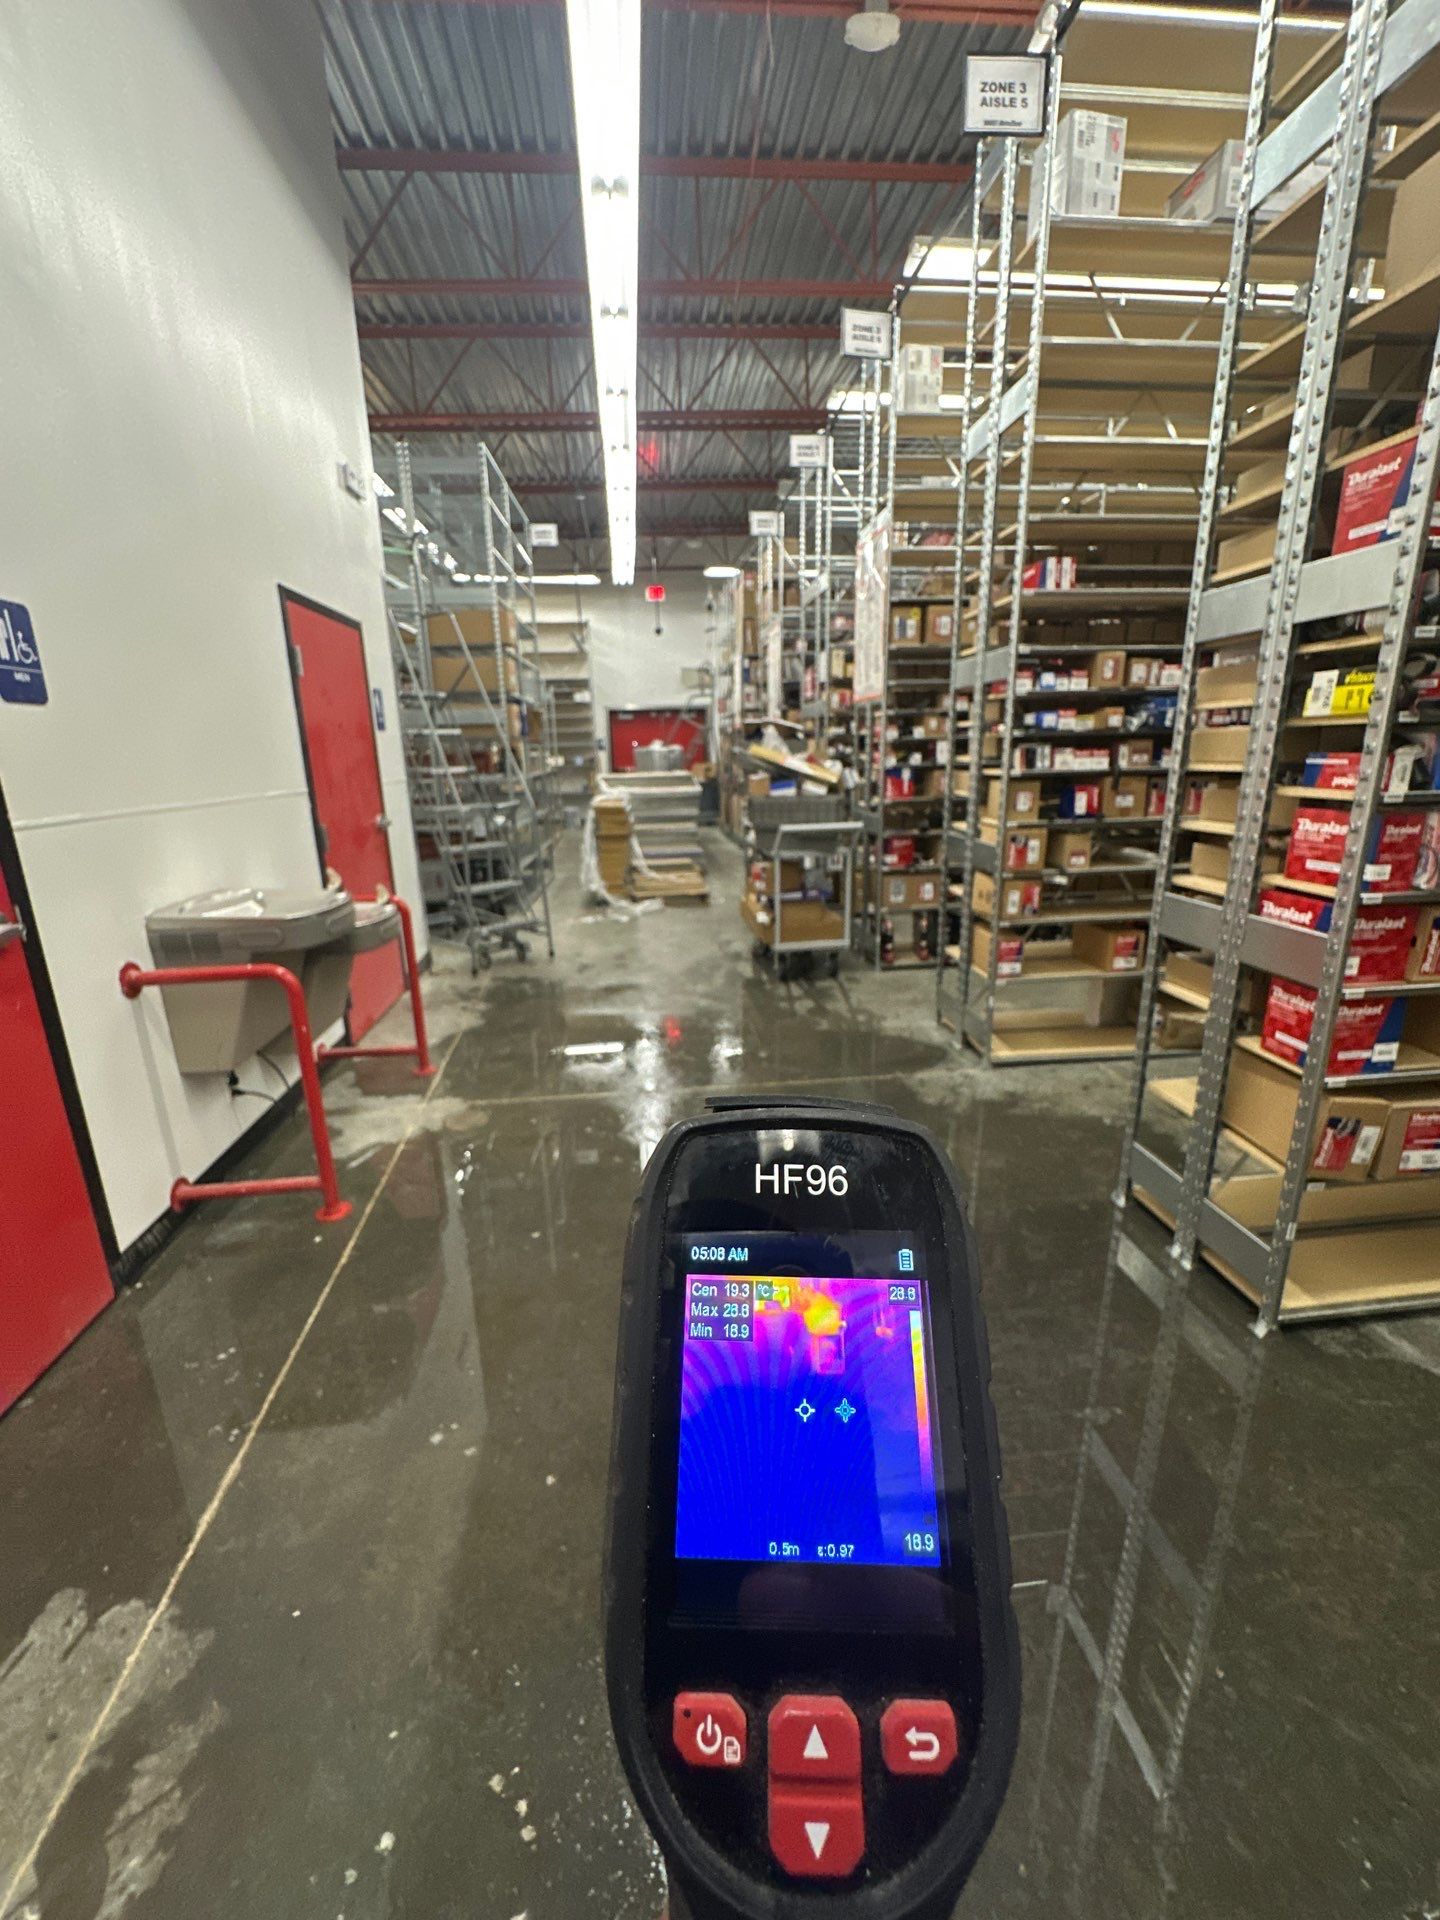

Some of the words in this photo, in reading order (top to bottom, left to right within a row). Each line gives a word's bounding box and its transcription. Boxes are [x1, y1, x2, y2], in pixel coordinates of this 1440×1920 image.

[980, 81, 1016, 93] ZONE
[1019, 82, 1027, 93] 3
[980, 96, 1017, 108] AISLE
[1020, 97, 1029, 108] 5
[1261, 899, 1314, 925] Duralast
[755, 1162, 849, 1197] HF96
[691, 1245, 726, 1261] 05:08
[727, 1246, 749, 1261] AM
[691, 1282, 718, 1297] Cen
[724, 1282, 750, 1298] 19.3
[690, 1302, 719, 1317] Max
[689, 1322, 713, 1338] Min
[723, 1323, 750, 1339] 18.9
[769, 1541, 800, 1556] 0.5m
